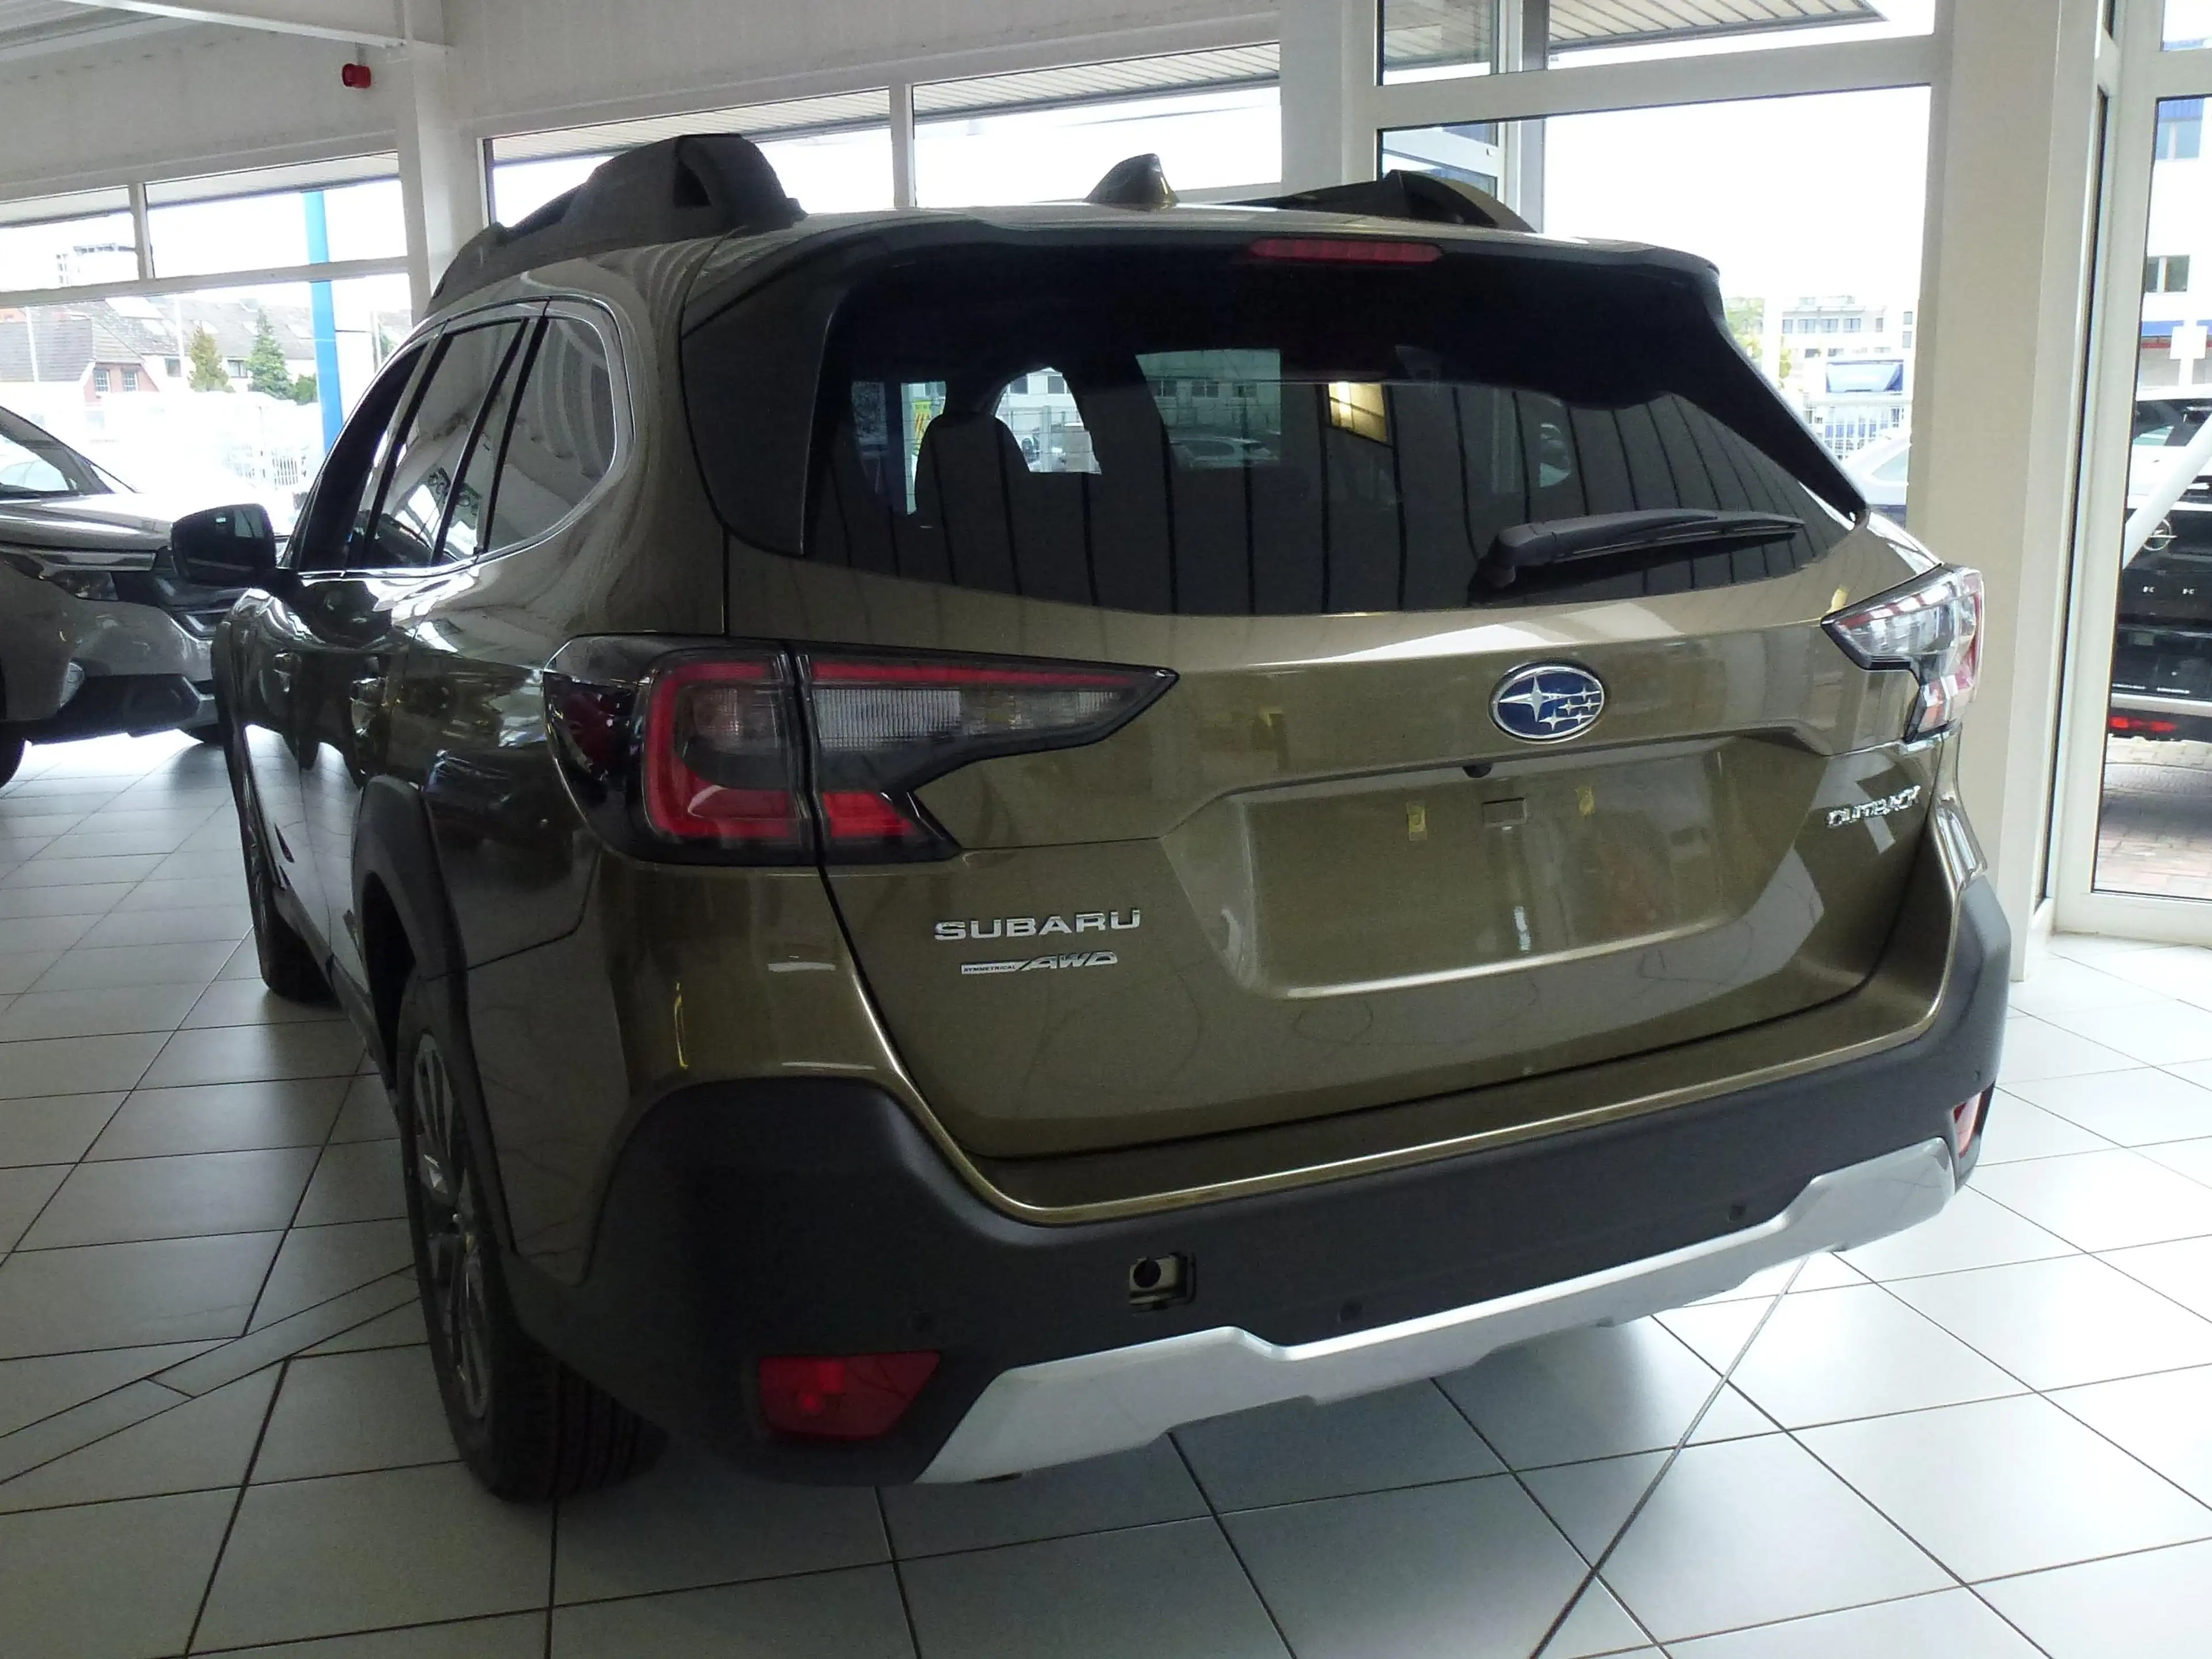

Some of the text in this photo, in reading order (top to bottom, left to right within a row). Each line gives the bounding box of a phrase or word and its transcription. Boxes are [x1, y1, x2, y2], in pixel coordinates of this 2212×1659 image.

[1825, 785, 1921, 825] OUTBACK
[934, 908, 1141, 941] SUBARU
[963, 950, 1118, 974] SYMMETRICAL AWD
